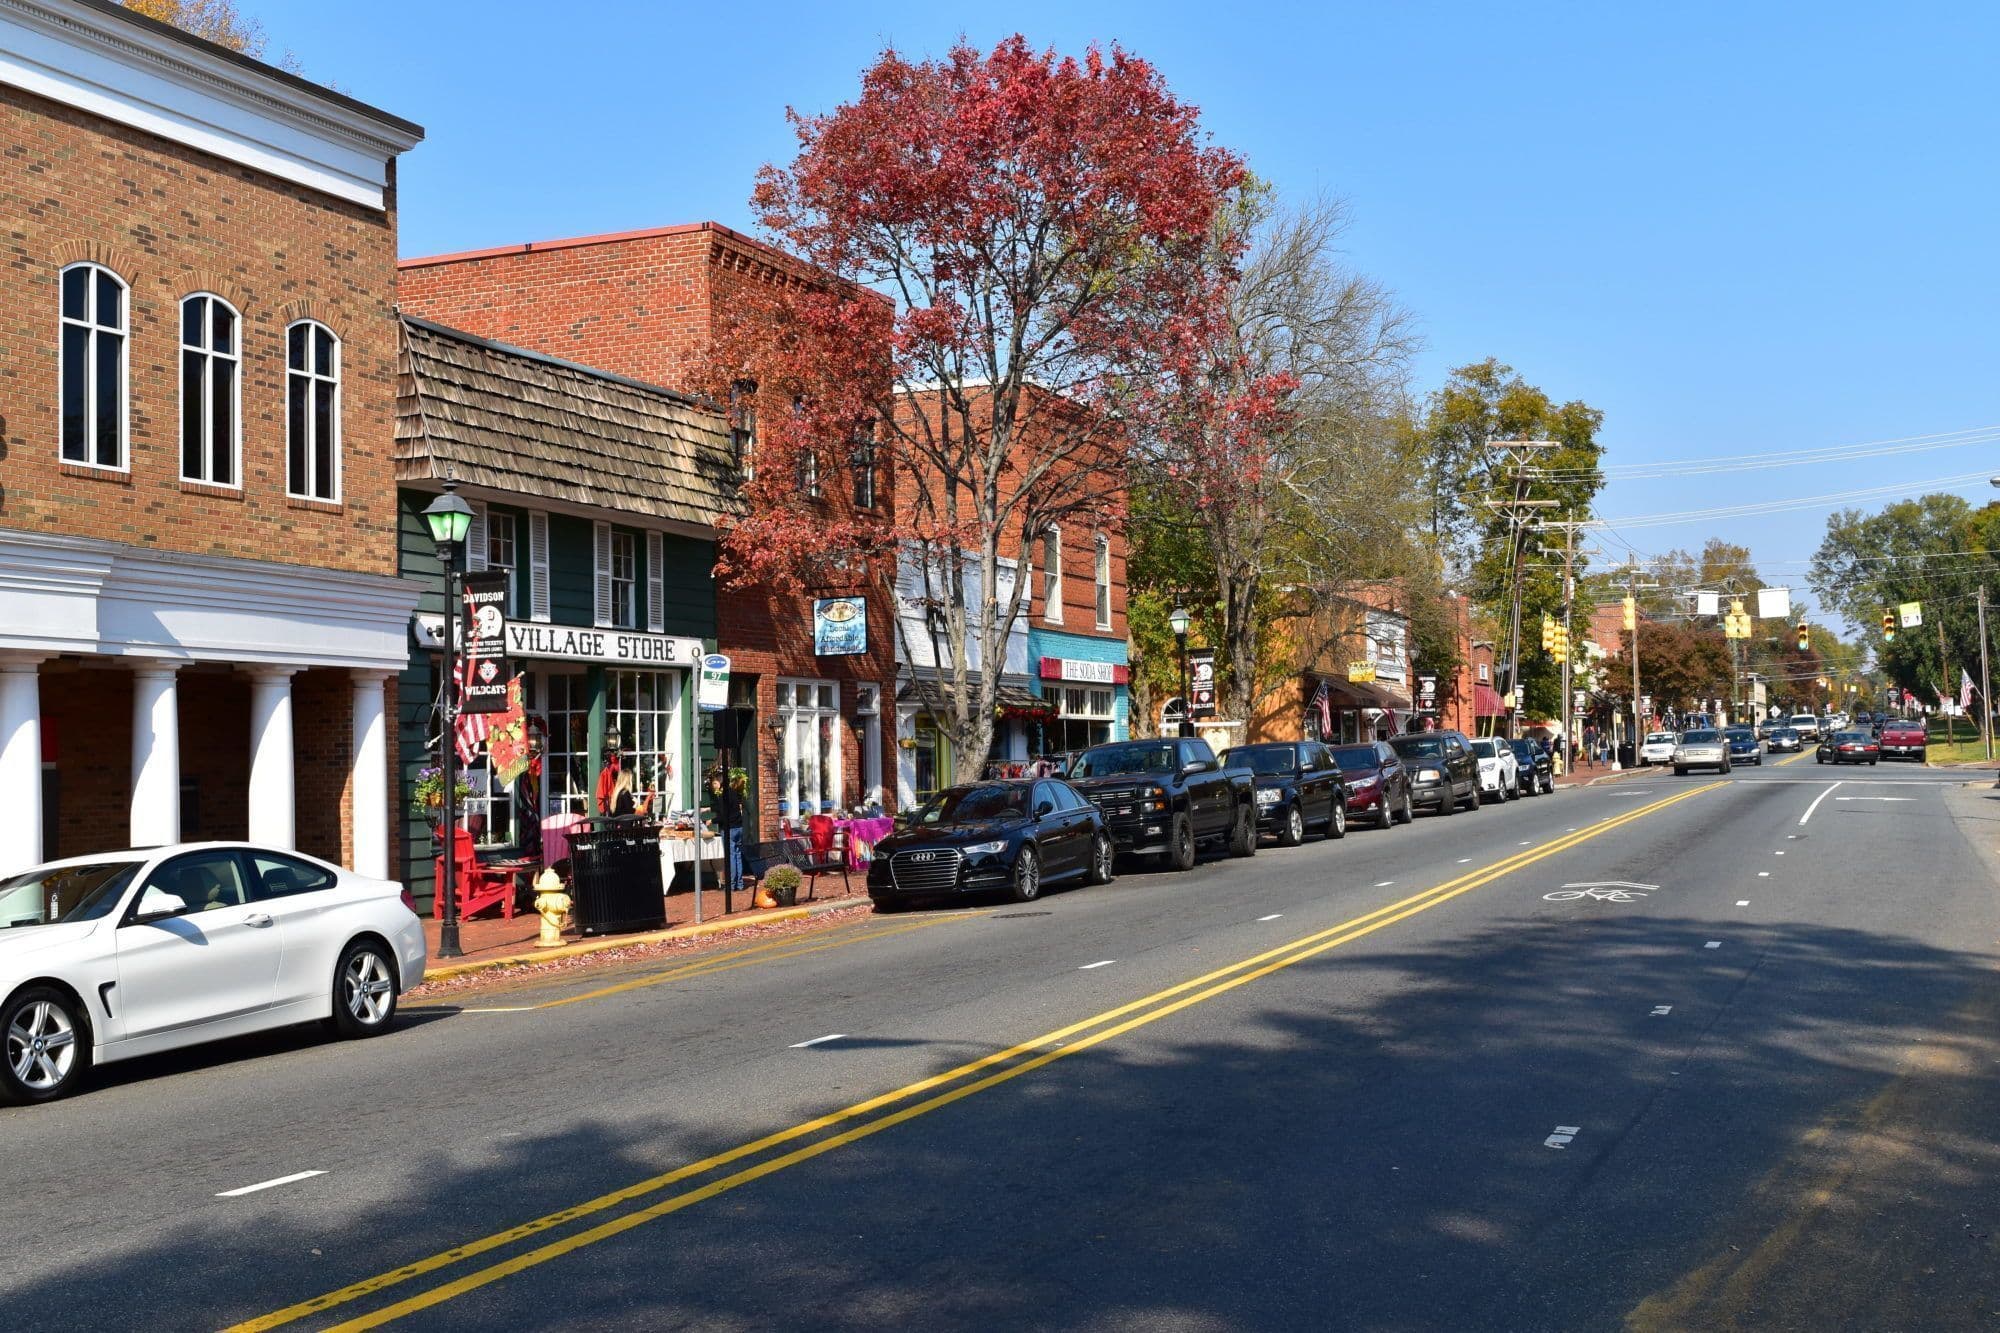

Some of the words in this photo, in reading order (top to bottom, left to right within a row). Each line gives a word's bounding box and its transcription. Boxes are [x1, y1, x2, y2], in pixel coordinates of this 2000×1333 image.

[463, 591, 504, 604] DAVIDSON
[510, 626, 604, 657] VILLAGE
[617, 635, 676, 661] STORE
[711, 672, 721, 681] 97
[1065, 661, 1078, 679] THE
[1079, 663, 1096, 680] SODA
[1097, 664, 1112, 681] SHOP
[465, 684, 506, 696] WILDCATS
